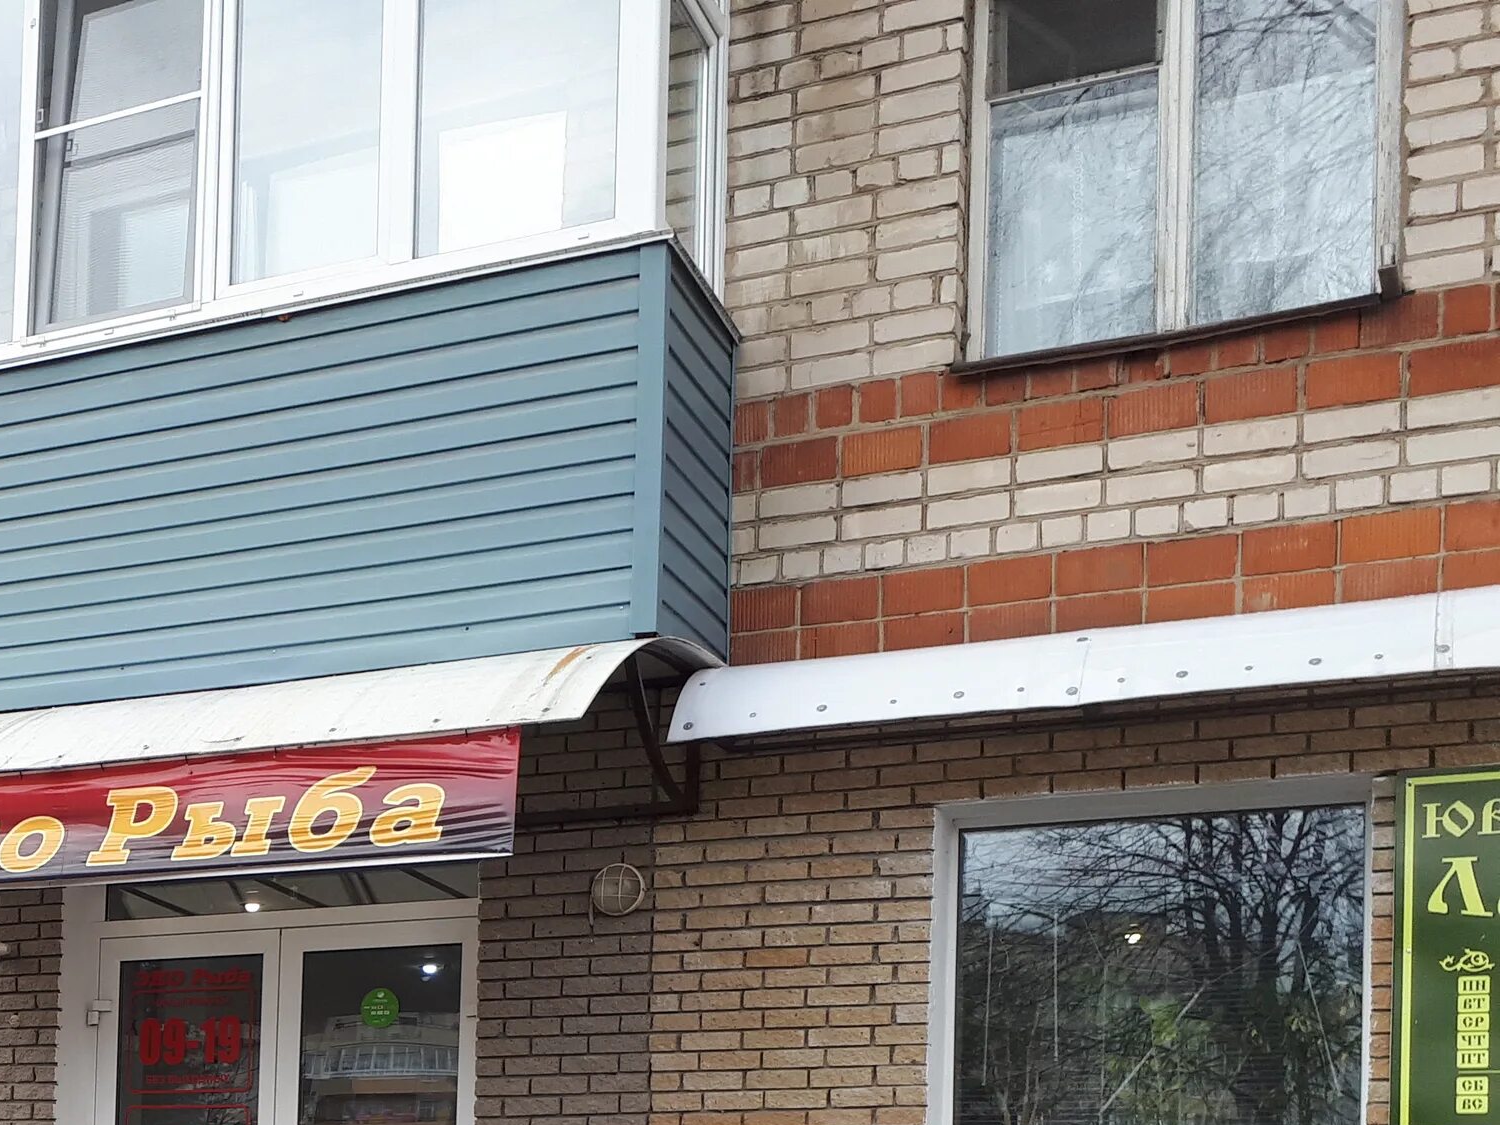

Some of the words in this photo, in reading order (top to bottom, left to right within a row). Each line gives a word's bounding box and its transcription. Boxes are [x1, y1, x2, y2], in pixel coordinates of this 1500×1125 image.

[85, 766, 445, 867] Рыба
[1427, 856, 1500, 917] Л
[1463, 980, 1485, 991] ПН
[1463, 998, 1485, 1009] ВТ
[1462, 1016, 1484, 1027] СР
[139, 1015, 241, 1066] 09-19
[1462, 1034, 1485, 1046] ЧТ
[1461, 1053, 1485, 1064] ПТ
[1462, 1079, 1483, 1091] СБ
[1462, 1098, 1482, 1110] ВС
